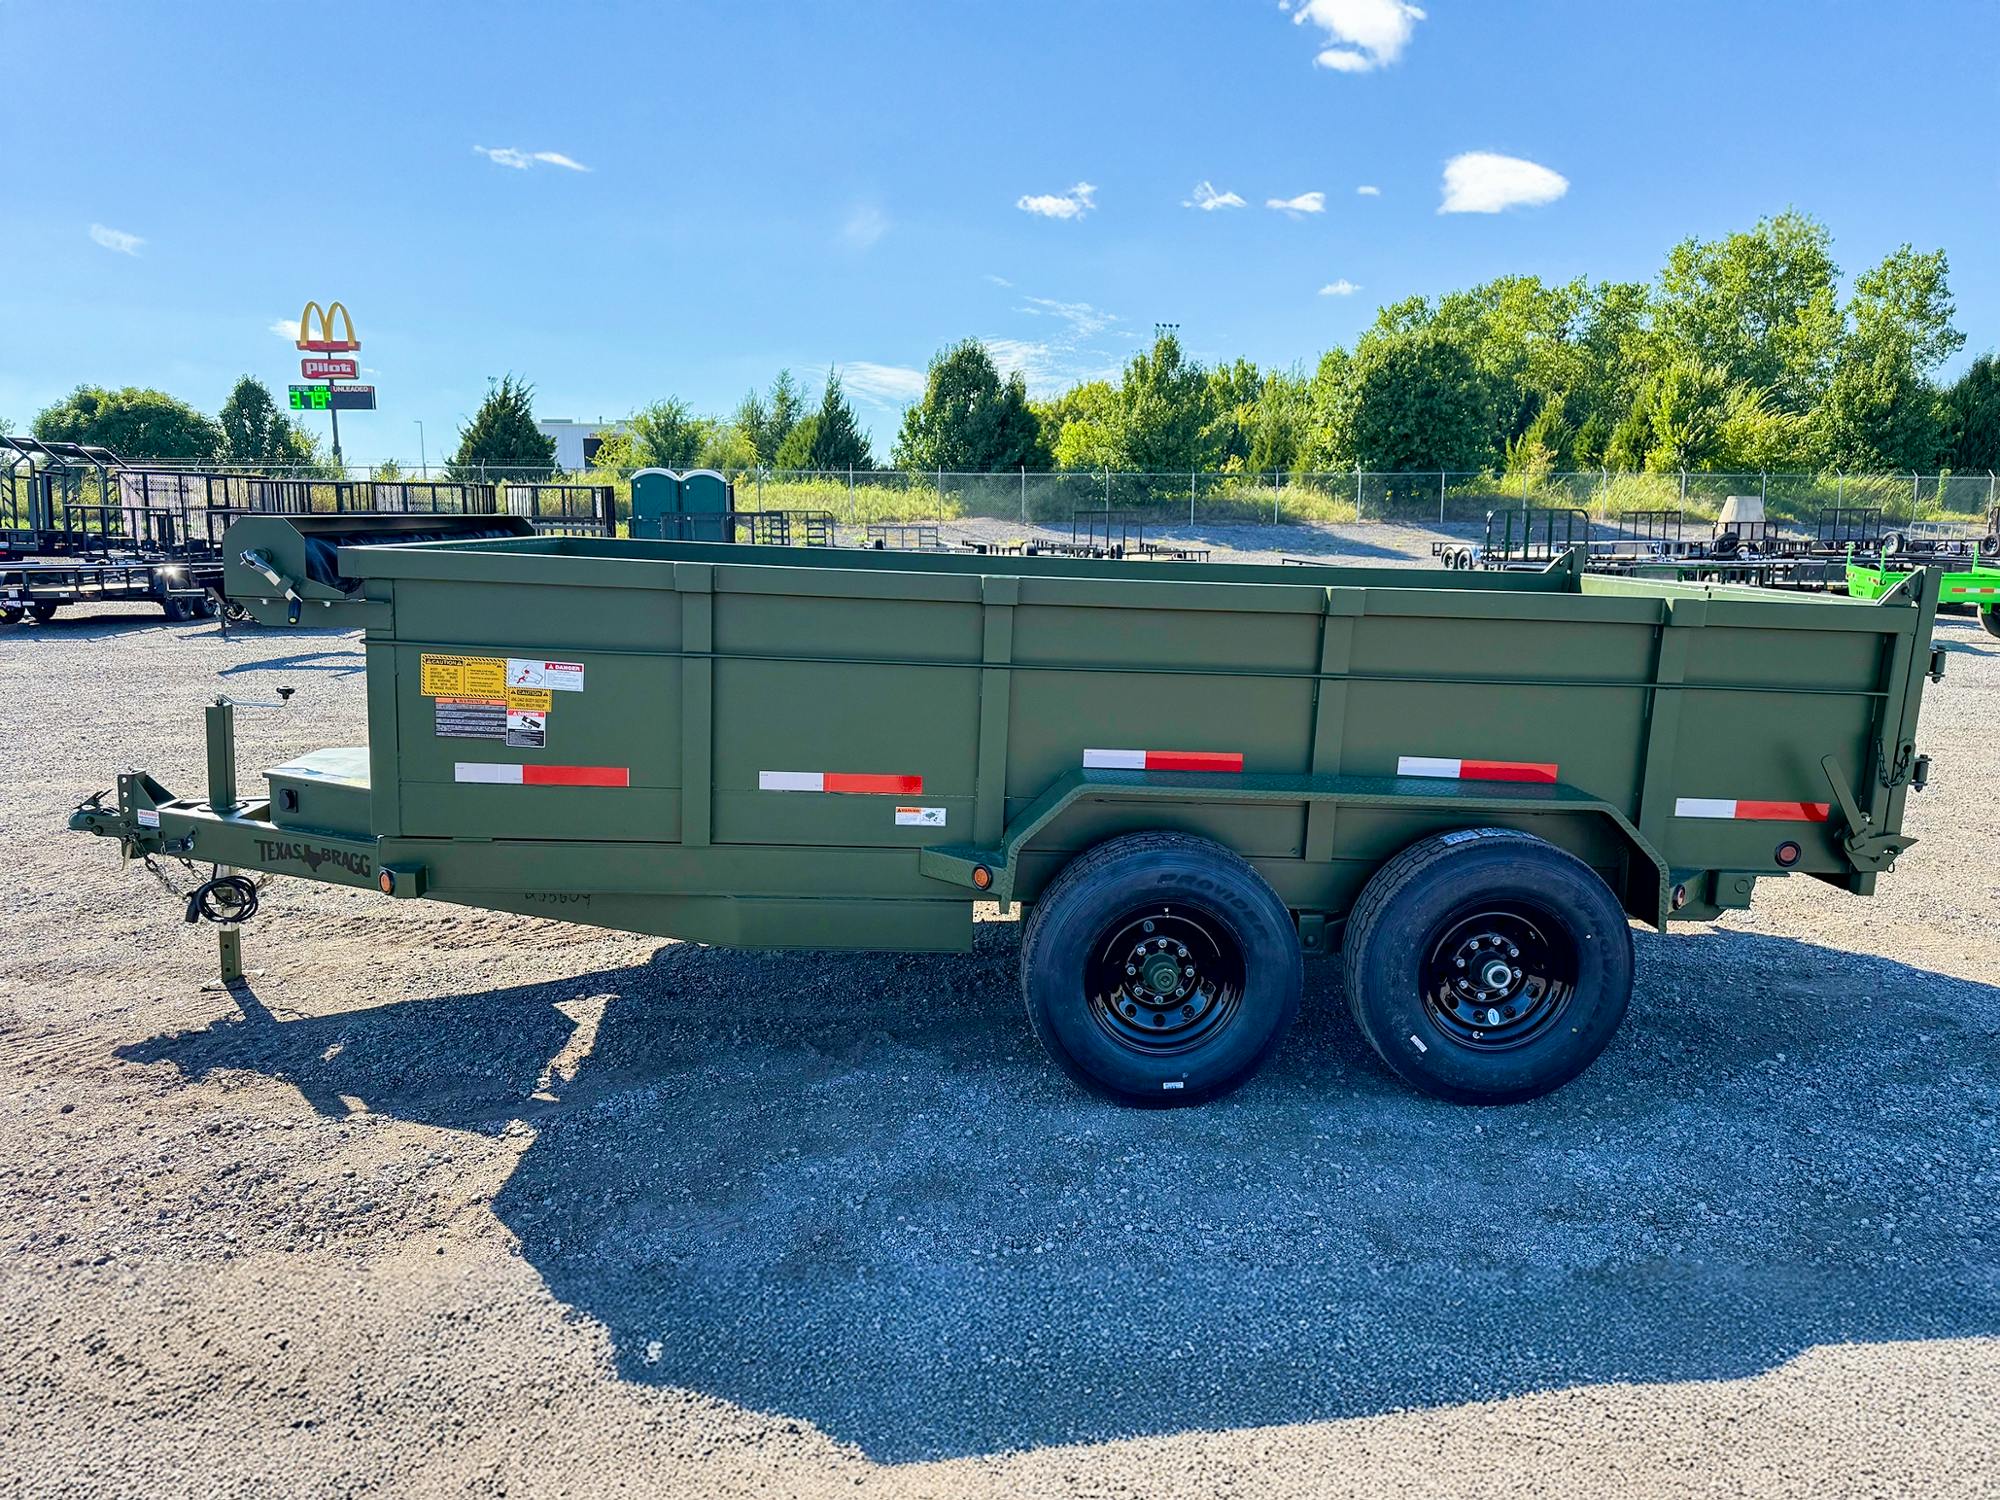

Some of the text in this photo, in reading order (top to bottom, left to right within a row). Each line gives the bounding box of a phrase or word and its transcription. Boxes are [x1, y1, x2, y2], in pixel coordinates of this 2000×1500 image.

[554, 664, 581, 672] DANGER
[254, 839, 371, 878] TEXAS BRAGG
